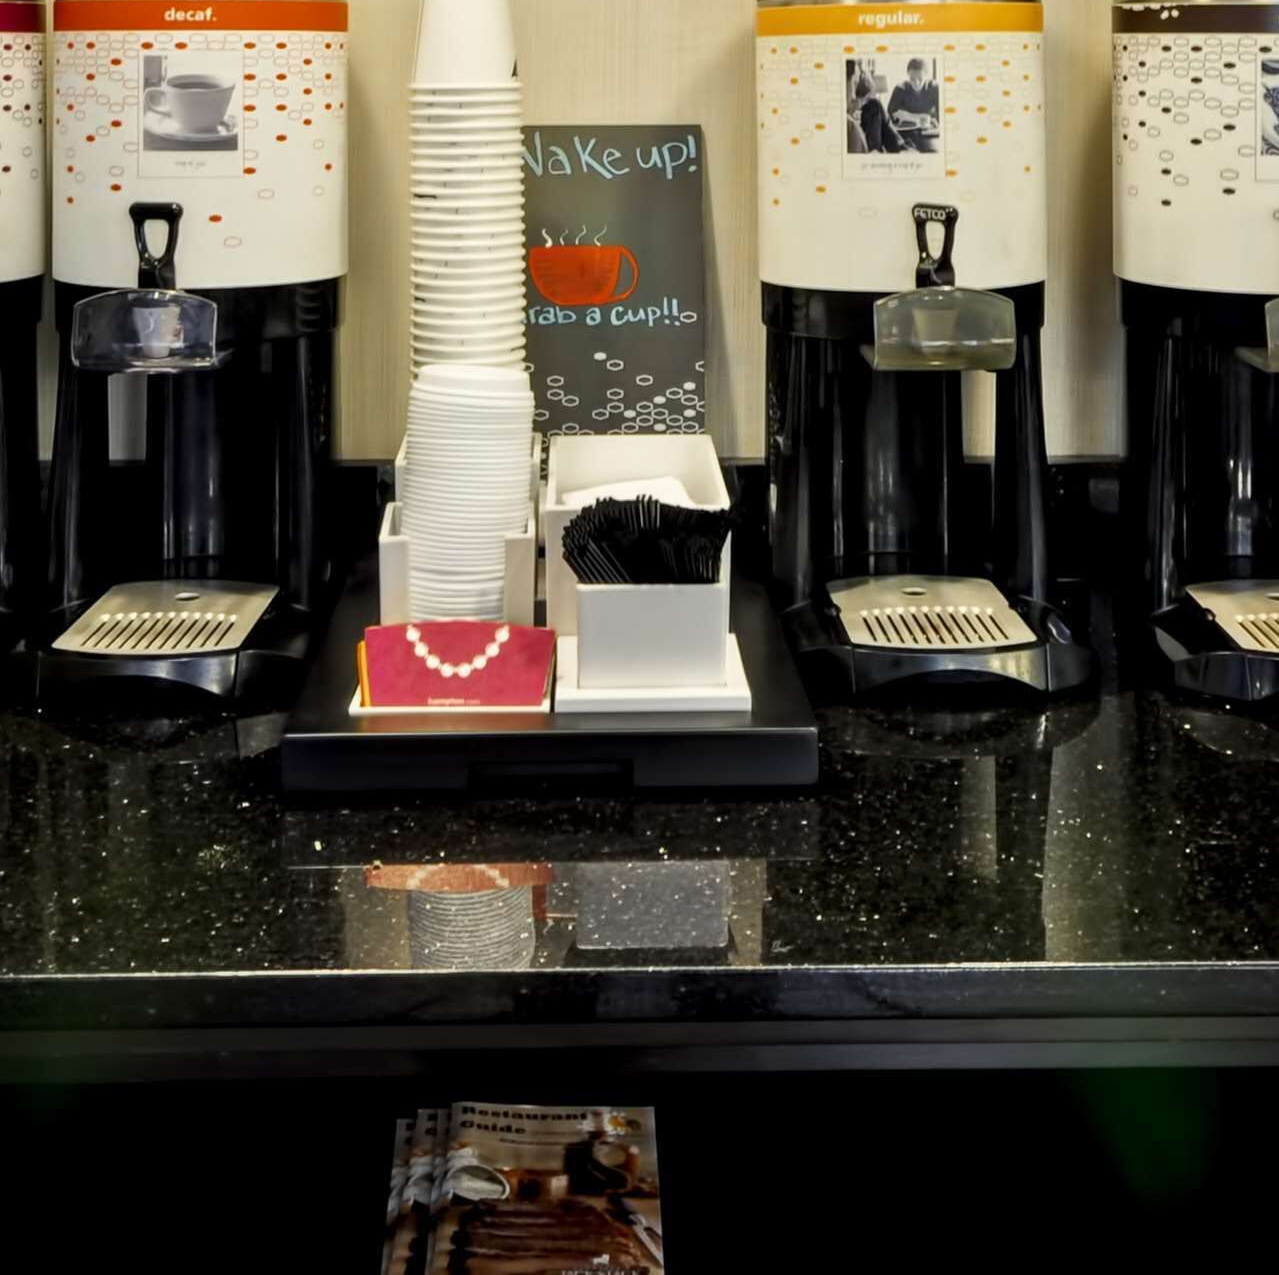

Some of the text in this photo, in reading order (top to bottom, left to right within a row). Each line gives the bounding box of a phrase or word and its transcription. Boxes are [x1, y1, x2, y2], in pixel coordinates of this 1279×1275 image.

[163, 6, 218, 22] decaf.
[858, 10, 925, 30] regular.
[636, 135, 697, 180] up!
[914, 207, 946, 221] FETCO
[524, 305, 577, 325] rab
[585, 306, 602, 326] a
[462, 1106, 588, 1120] Restaurant
[460, 1120, 527, 1135] Guide
